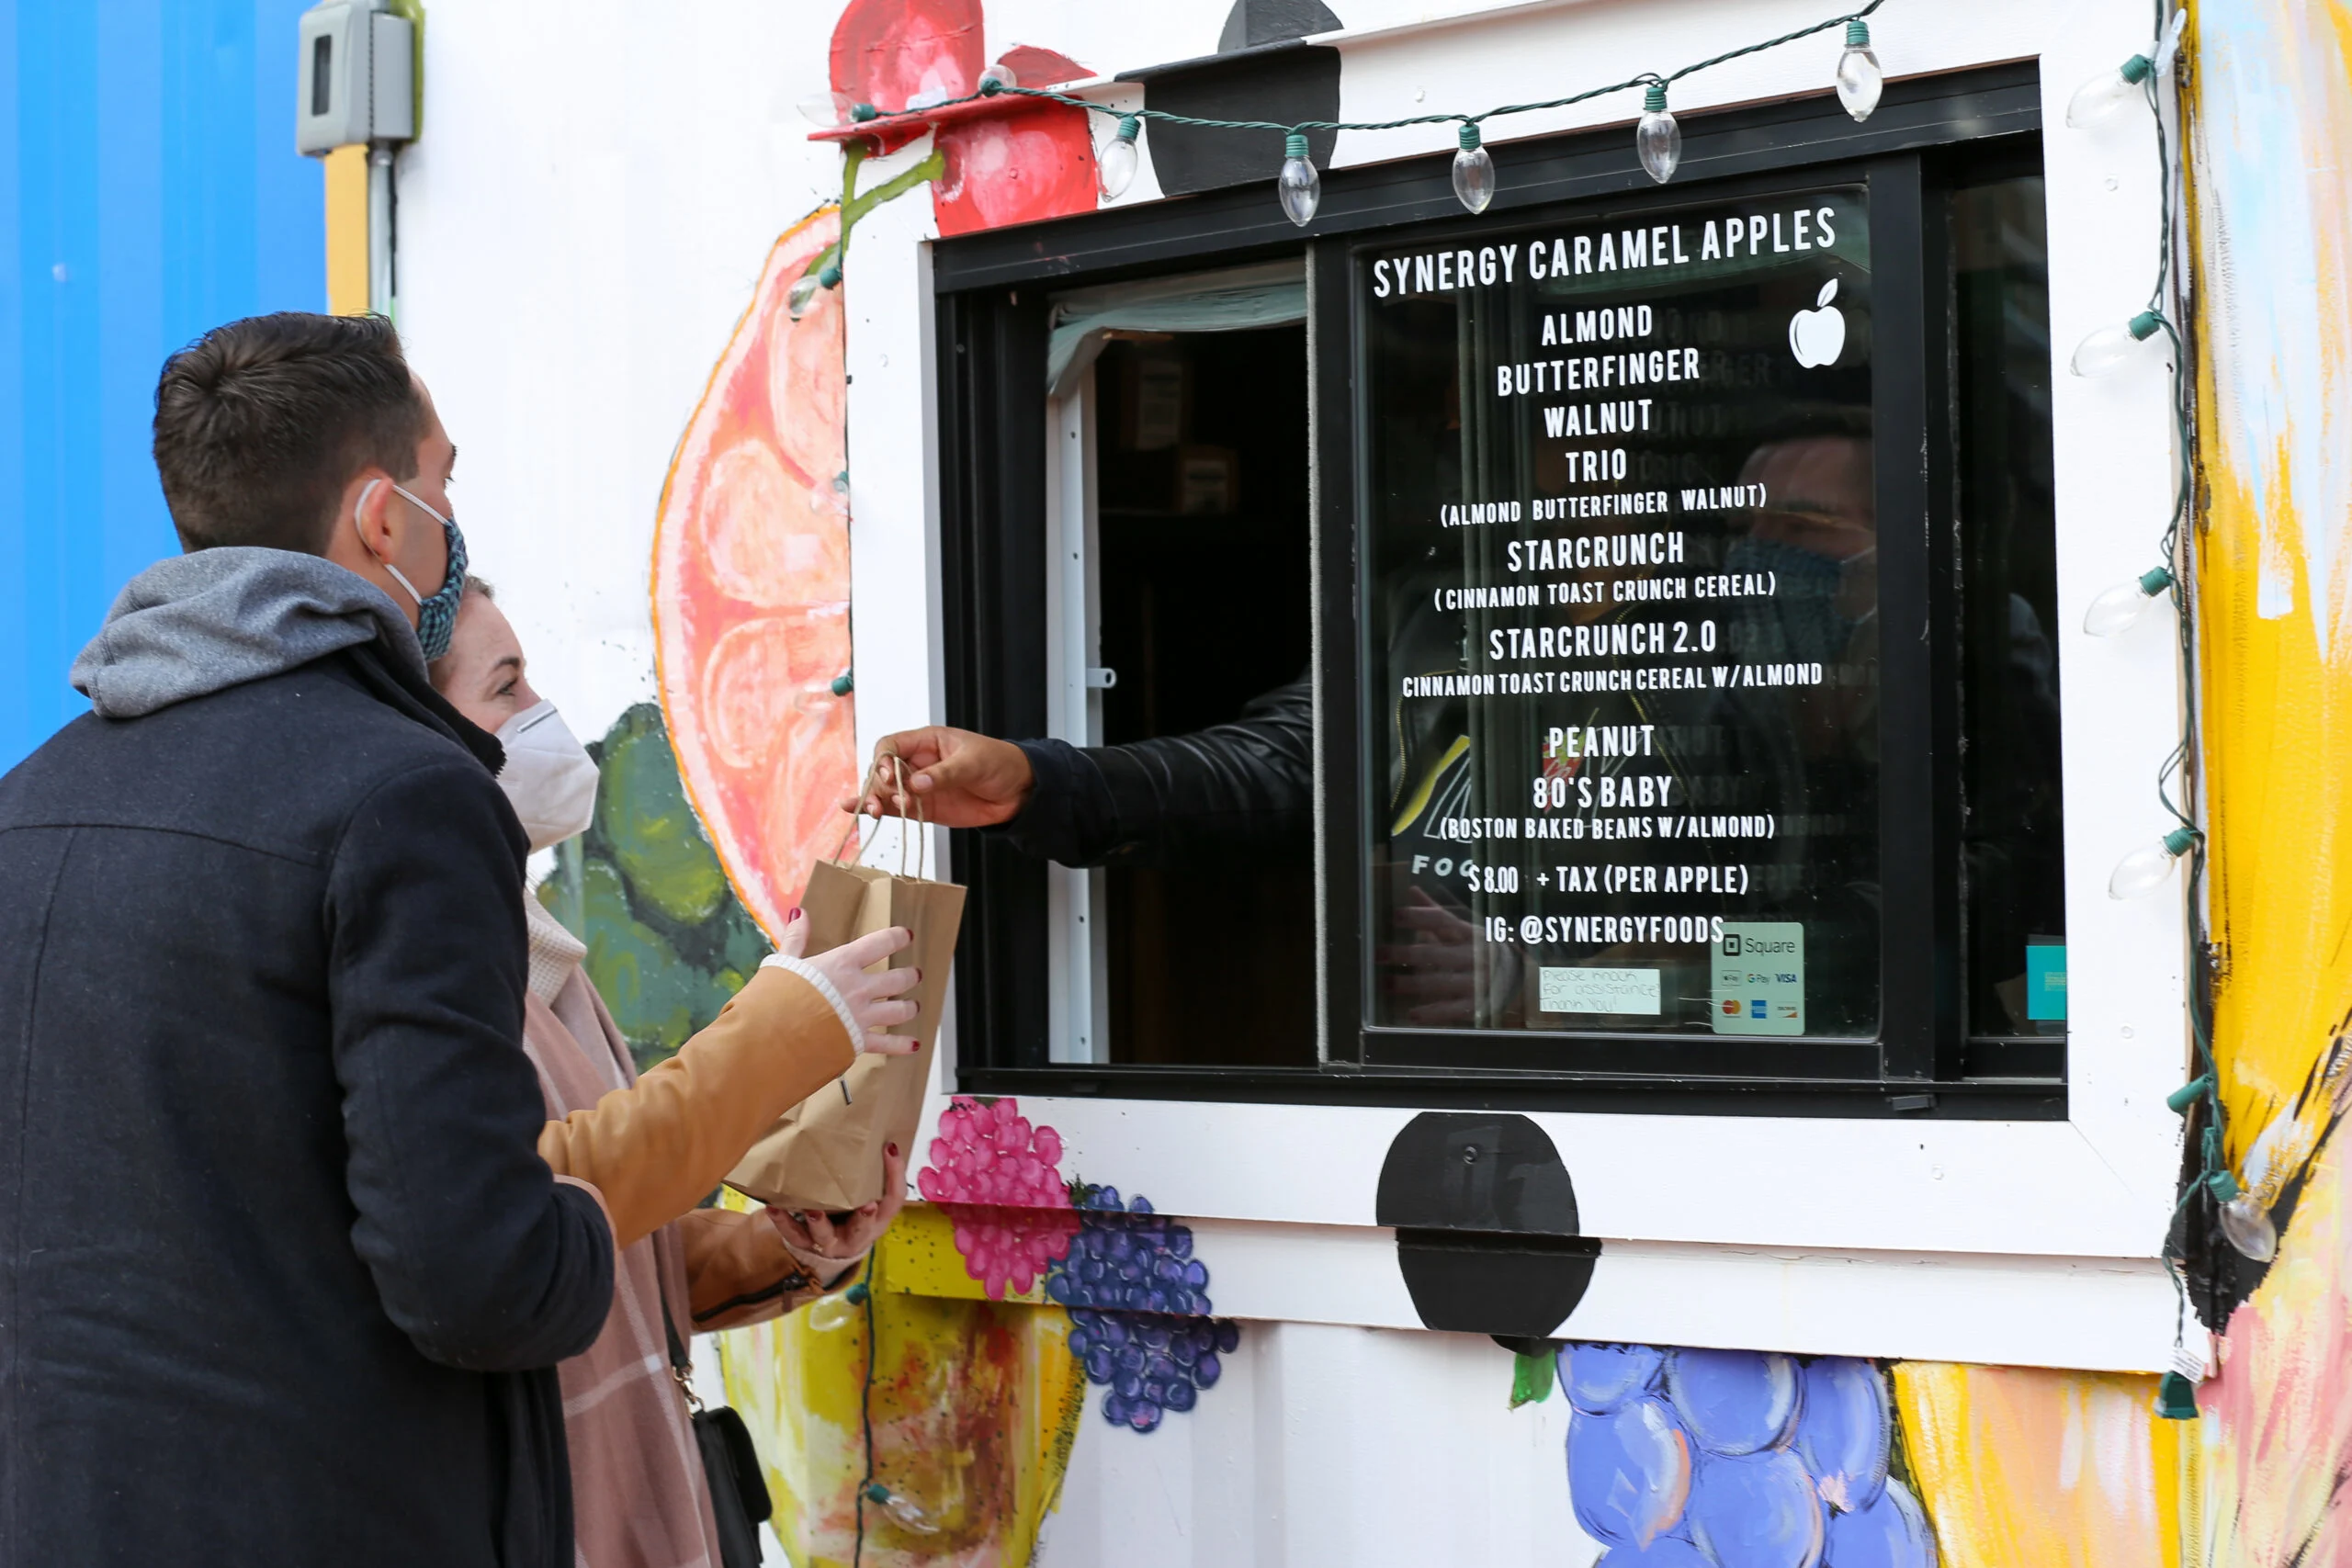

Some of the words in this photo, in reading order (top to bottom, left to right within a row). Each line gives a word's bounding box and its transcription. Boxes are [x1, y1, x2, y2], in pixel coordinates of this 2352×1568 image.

[1374, 243, 1518, 298] SYNERGY
[1529, 224, 1690, 280] CARAMEL
[1701, 207, 1836, 261] APPLES
[1542, 305, 1653, 346] ALMOND
[1498, 347, 1701, 397] BUTTERFINGER
[1544, 399, 1653, 438] WALNUT
[1565, 448, 1626, 483] TRIO
[1441, 501, 1521, 528] (ALMOND
[1532, 491, 1668, 521] BUTTERFINGER
[1680, 482, 1767, 511] WALNUT)
[1507, 531, 1684, 572] STARCRUNCH
[1546, 581, 1605, 605] TOAST
[1612, 577, 1687, 603] CRUNCH
[1694, 570, 1776, 598] CEREAL)
[1489, 622, 1665, 660] STARCRUNCH
[1673, 619, 1716, 653] 2.0
[1402, 673, 1495, 698] CINNAMON
[1498, 671, 1555, 694] TOAST
[1559, 669, 1632, 693] CRUNCH
[1635, 667, 1707, 691] CEREAL
[1711, 662, 1822, 688] W/ALMOND
[1549, 724, 1655, 758] PEANUT
[1533, 776, 1592, 808] 80'S
[1600, 775, 1672, 807] BABY
[1440, 817, 1518, 843] (BOSTON
[1525, 818, 1584, 840] BAKED
[1591, 816, 1653, 840] BEANS
[1657, 814, 1775, 839] W/ALMOND)
[1536, 873, 1550, 886] +
[1555, 866, 1598, 892] TAX
[1604, 863, 1657, 895] (PER
[1664, 863, 1748, 896] APPLE)
[1486, 916, 1514, 942] IG:
[1520, 915, 1724, 945] @SYNERGYFOODS
[1745, 937, 1795, 956] Square
[1774, 974, 1797, 983] VISA
